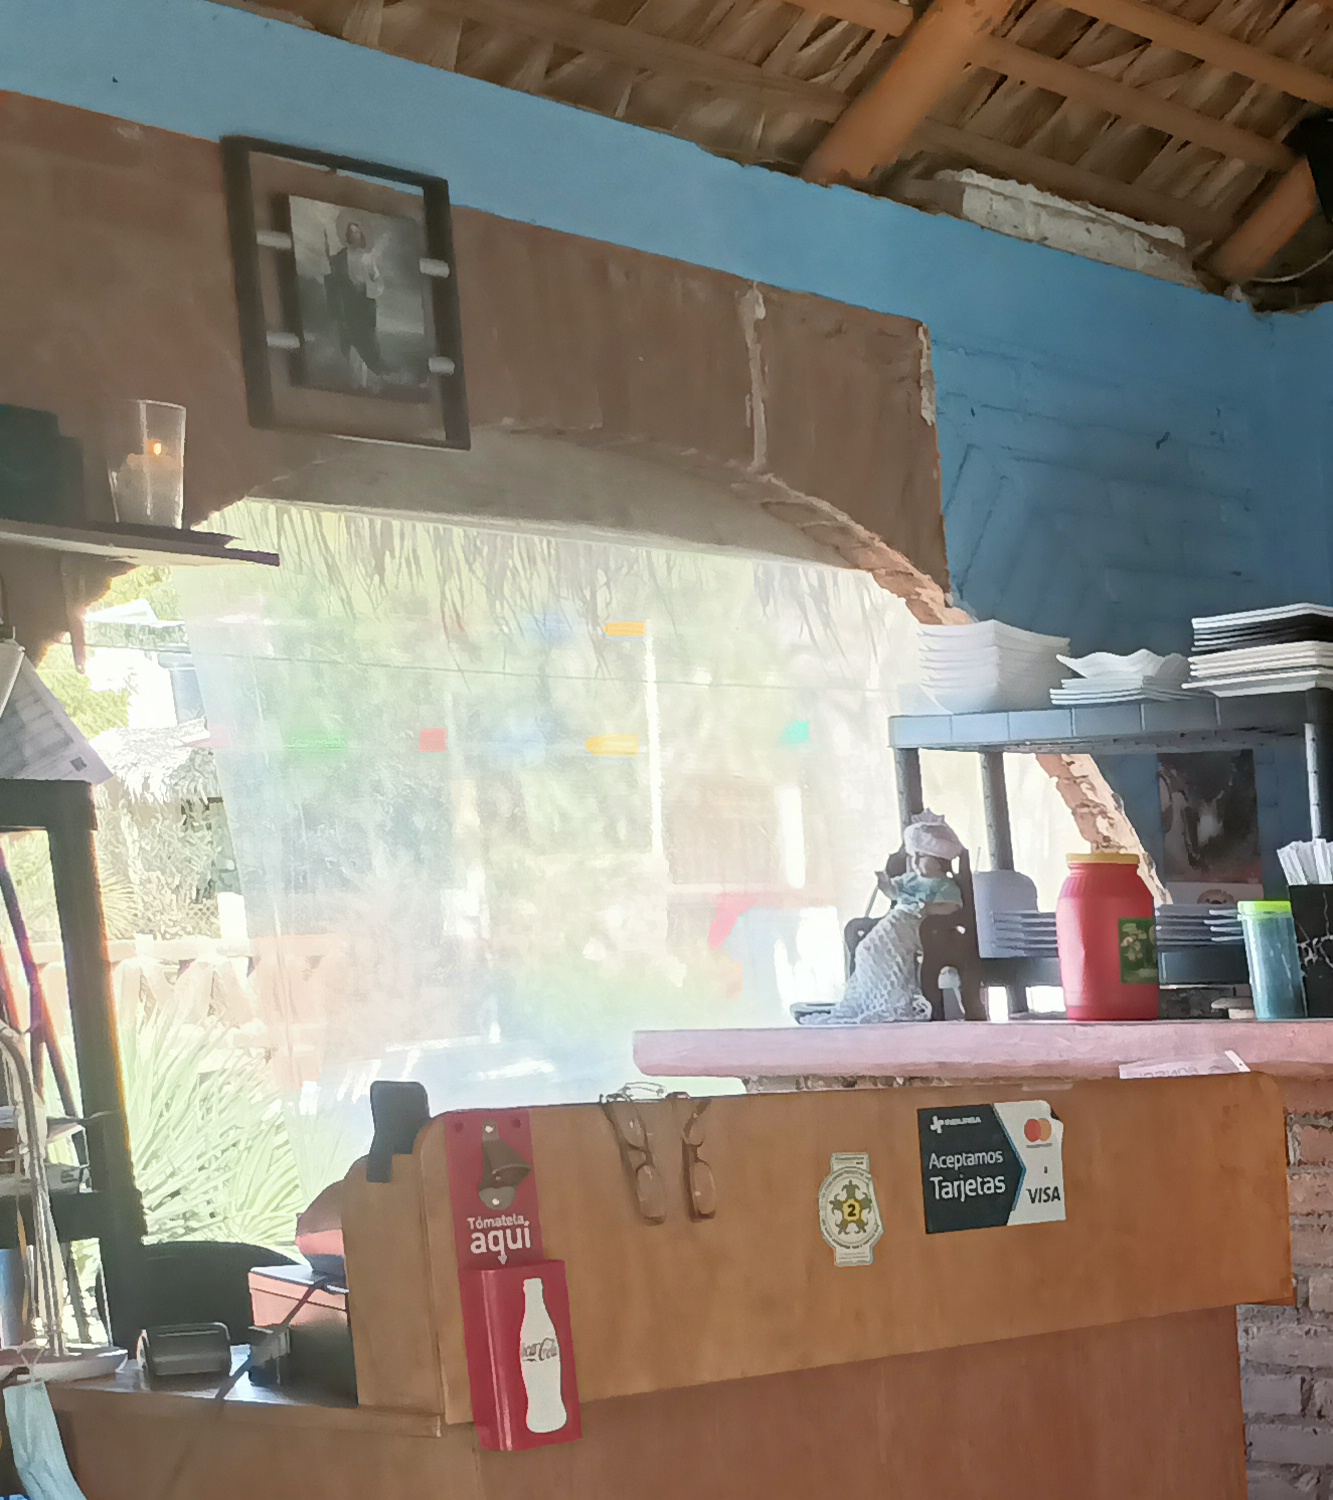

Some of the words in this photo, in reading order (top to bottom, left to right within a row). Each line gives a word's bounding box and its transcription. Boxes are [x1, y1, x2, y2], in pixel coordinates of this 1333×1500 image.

[929, 1151, 1003, 1171] Aceptamos
[929, 1174, 1006, 1202] Tarjetas
[1026, 1186, 1061, 1204] VISA
[847, 1203, 857, 1217] 2
[470, 1221, 532, 1258] aquí
